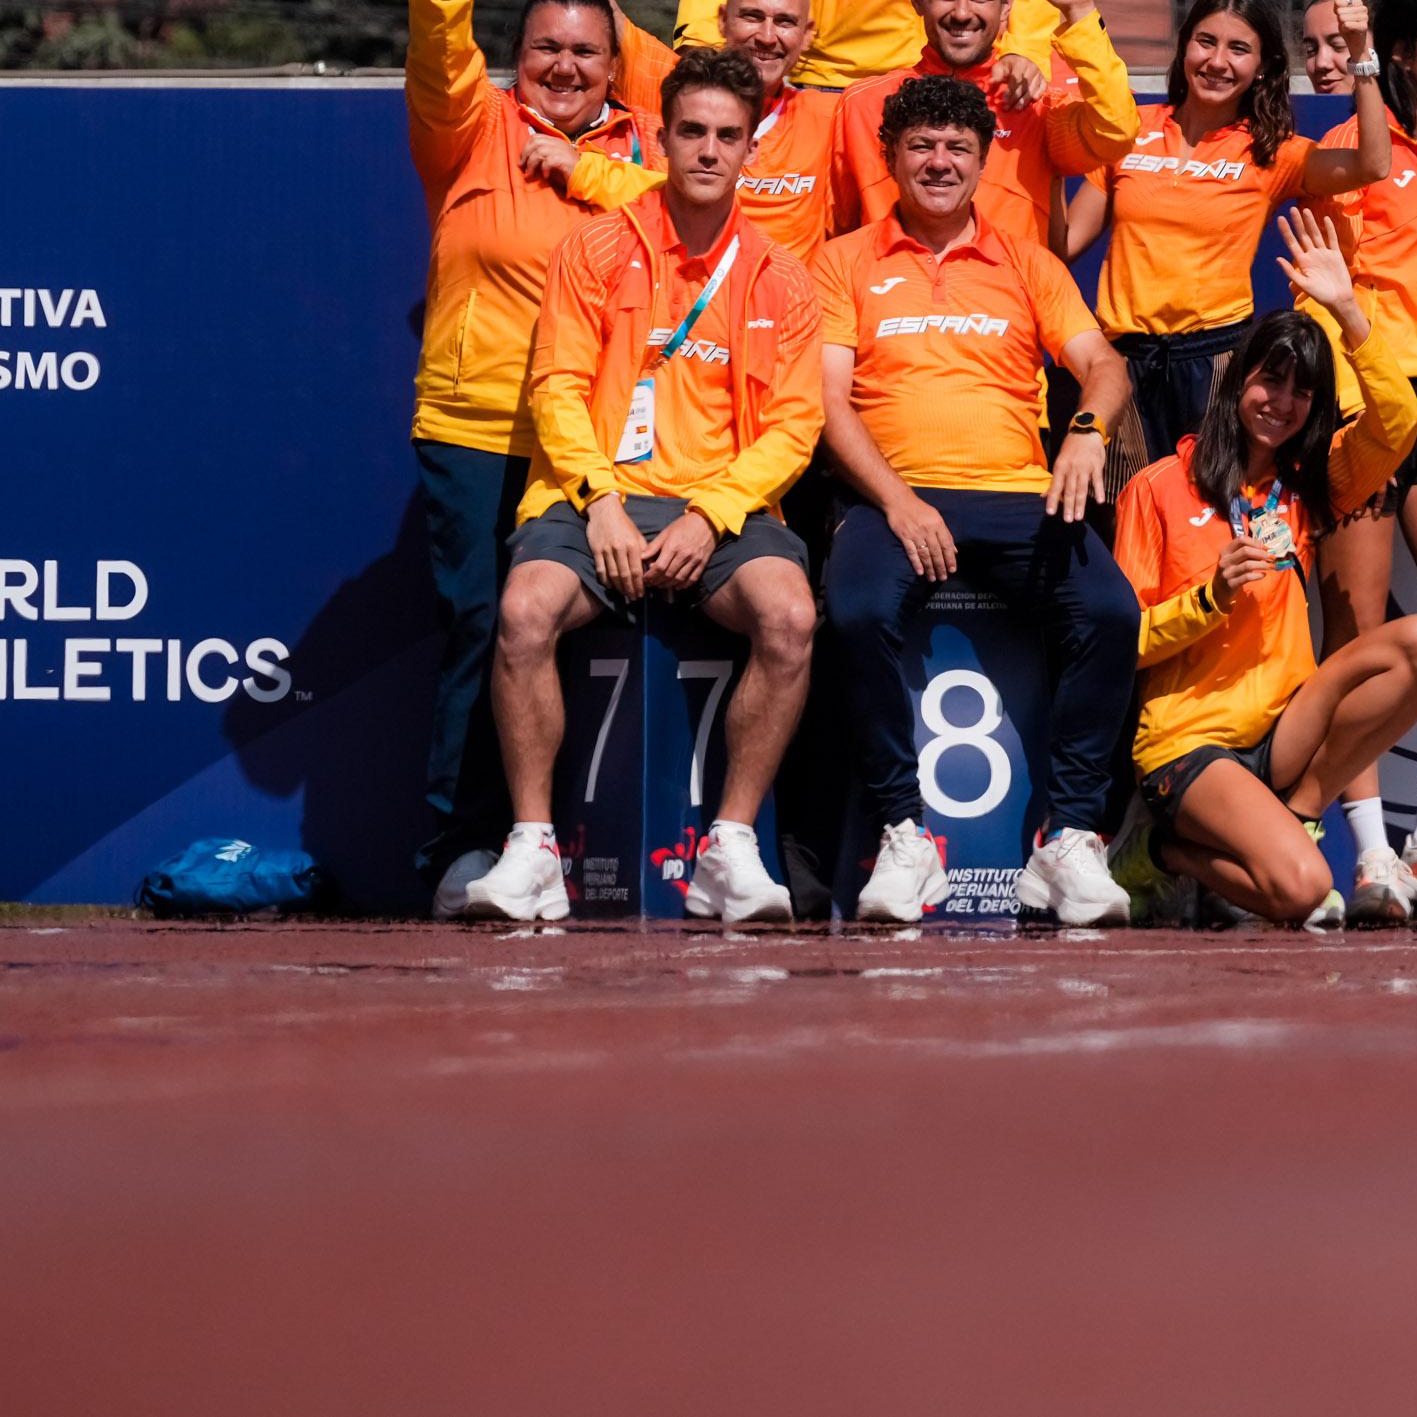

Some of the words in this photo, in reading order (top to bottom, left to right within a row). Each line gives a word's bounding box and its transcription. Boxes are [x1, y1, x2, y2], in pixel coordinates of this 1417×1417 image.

[1120, 153, 1246, 180] ESPAÑA
[876, 313, 1009, 339] ESPAÑA
[0, 637, 292, 703] LETICS
[584, 658, 629, 803] 7
[676, 659, 734, 807] 7
[917, 668, 1012, 818] 8
[945, 898, 974, 913] DEL
